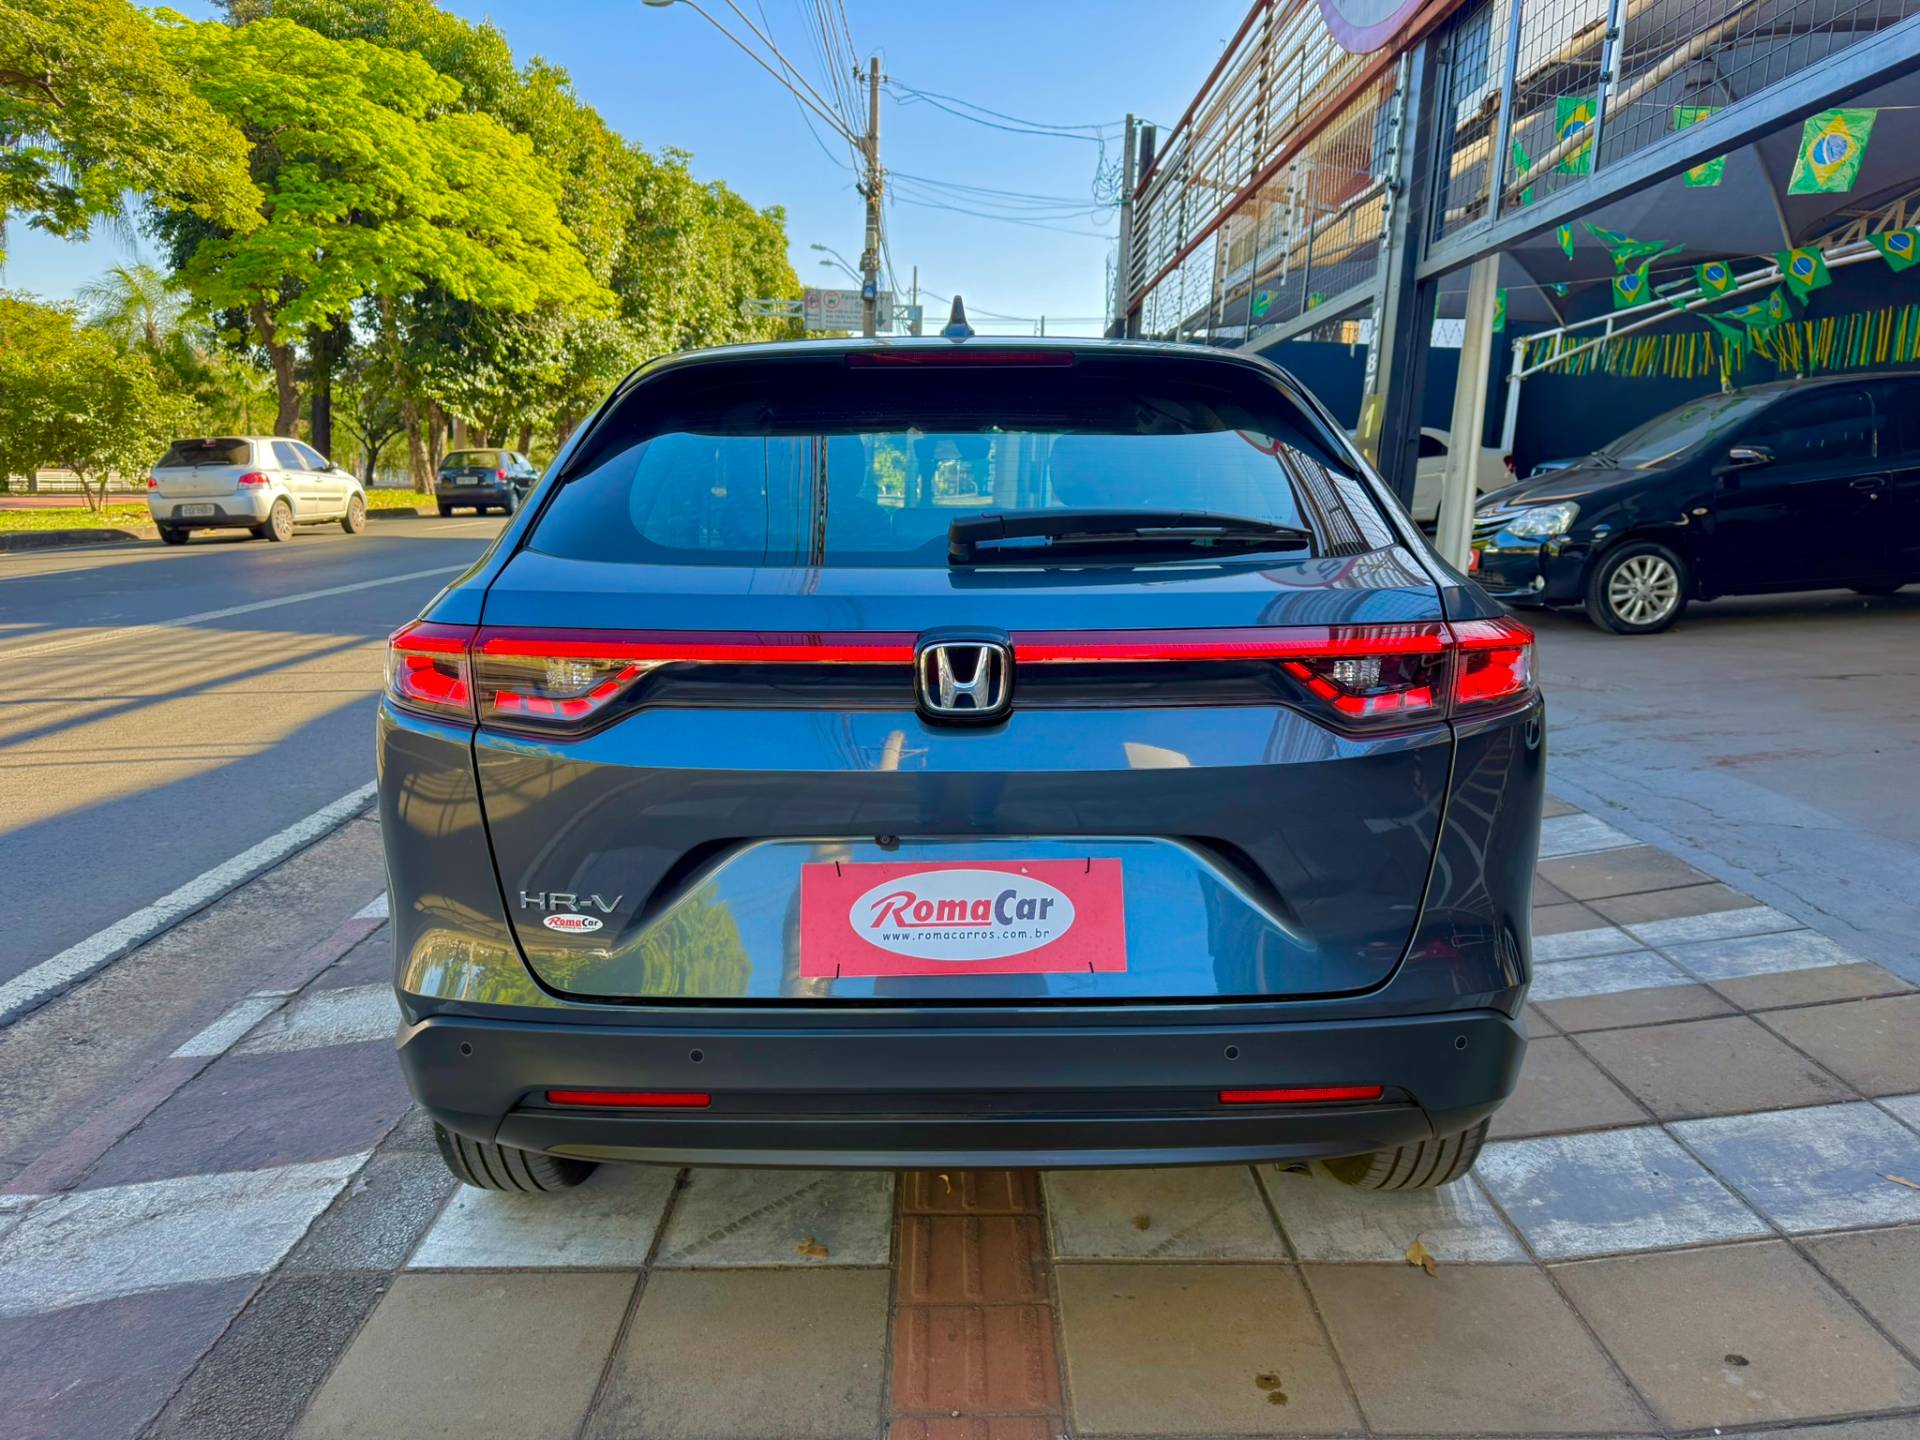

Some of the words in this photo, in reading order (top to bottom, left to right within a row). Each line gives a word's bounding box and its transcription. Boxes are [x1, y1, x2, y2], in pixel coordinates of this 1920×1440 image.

[1365, 307, 1380, 395] 1187
[520, 891, 623, 913] HR-V
[870, 889, 1054, 928] RomaCar
[882, 928, 1050, 941] www.romacarros.com.br
